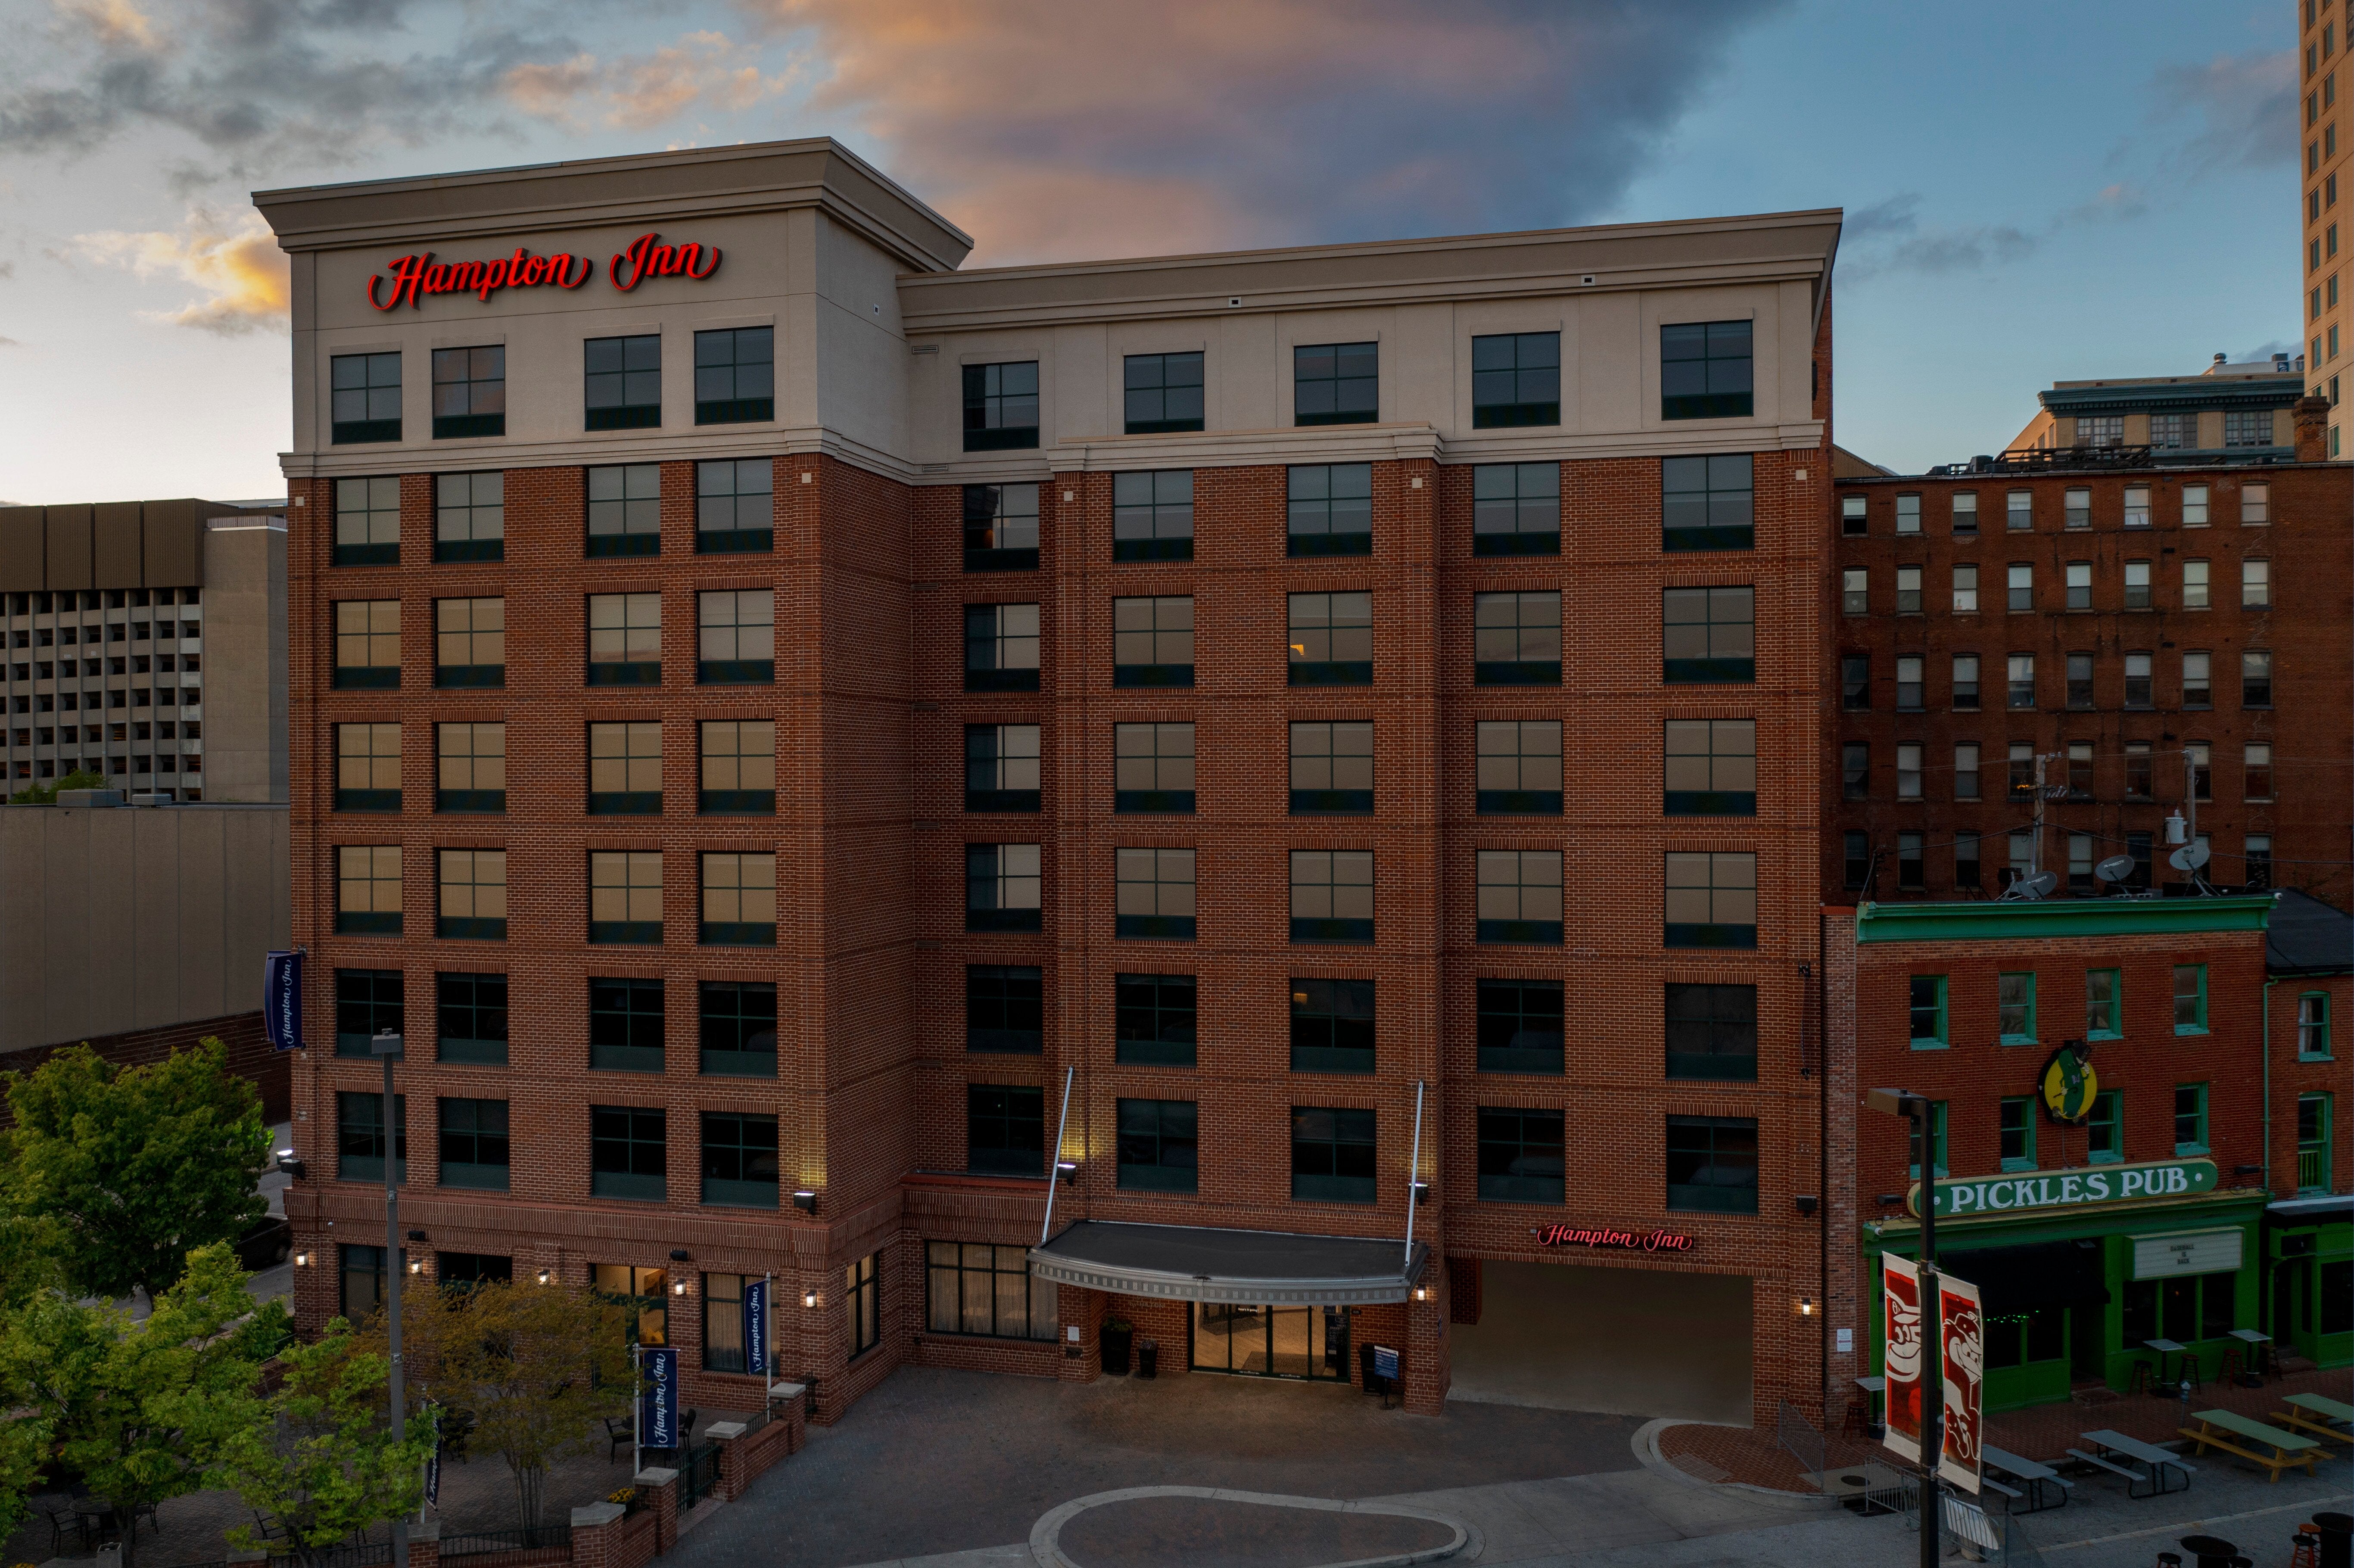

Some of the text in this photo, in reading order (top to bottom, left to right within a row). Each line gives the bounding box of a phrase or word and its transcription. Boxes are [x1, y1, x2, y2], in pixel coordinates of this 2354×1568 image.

[368, 233, 722, 311] Hampton Inn
[282, 959, 293, 986] Inn
[282, 988, 294, 1044] Hampton
[1950, 1167, 2189, 1212] PICKLES PUB
[1537, 1224, 1692, 1251] Hampton Inn
[750, 1286, 760, 1312] Inn
[752, 1313, 762, 1367] Hampton
[653, 1353, 667, 1382] Inn
